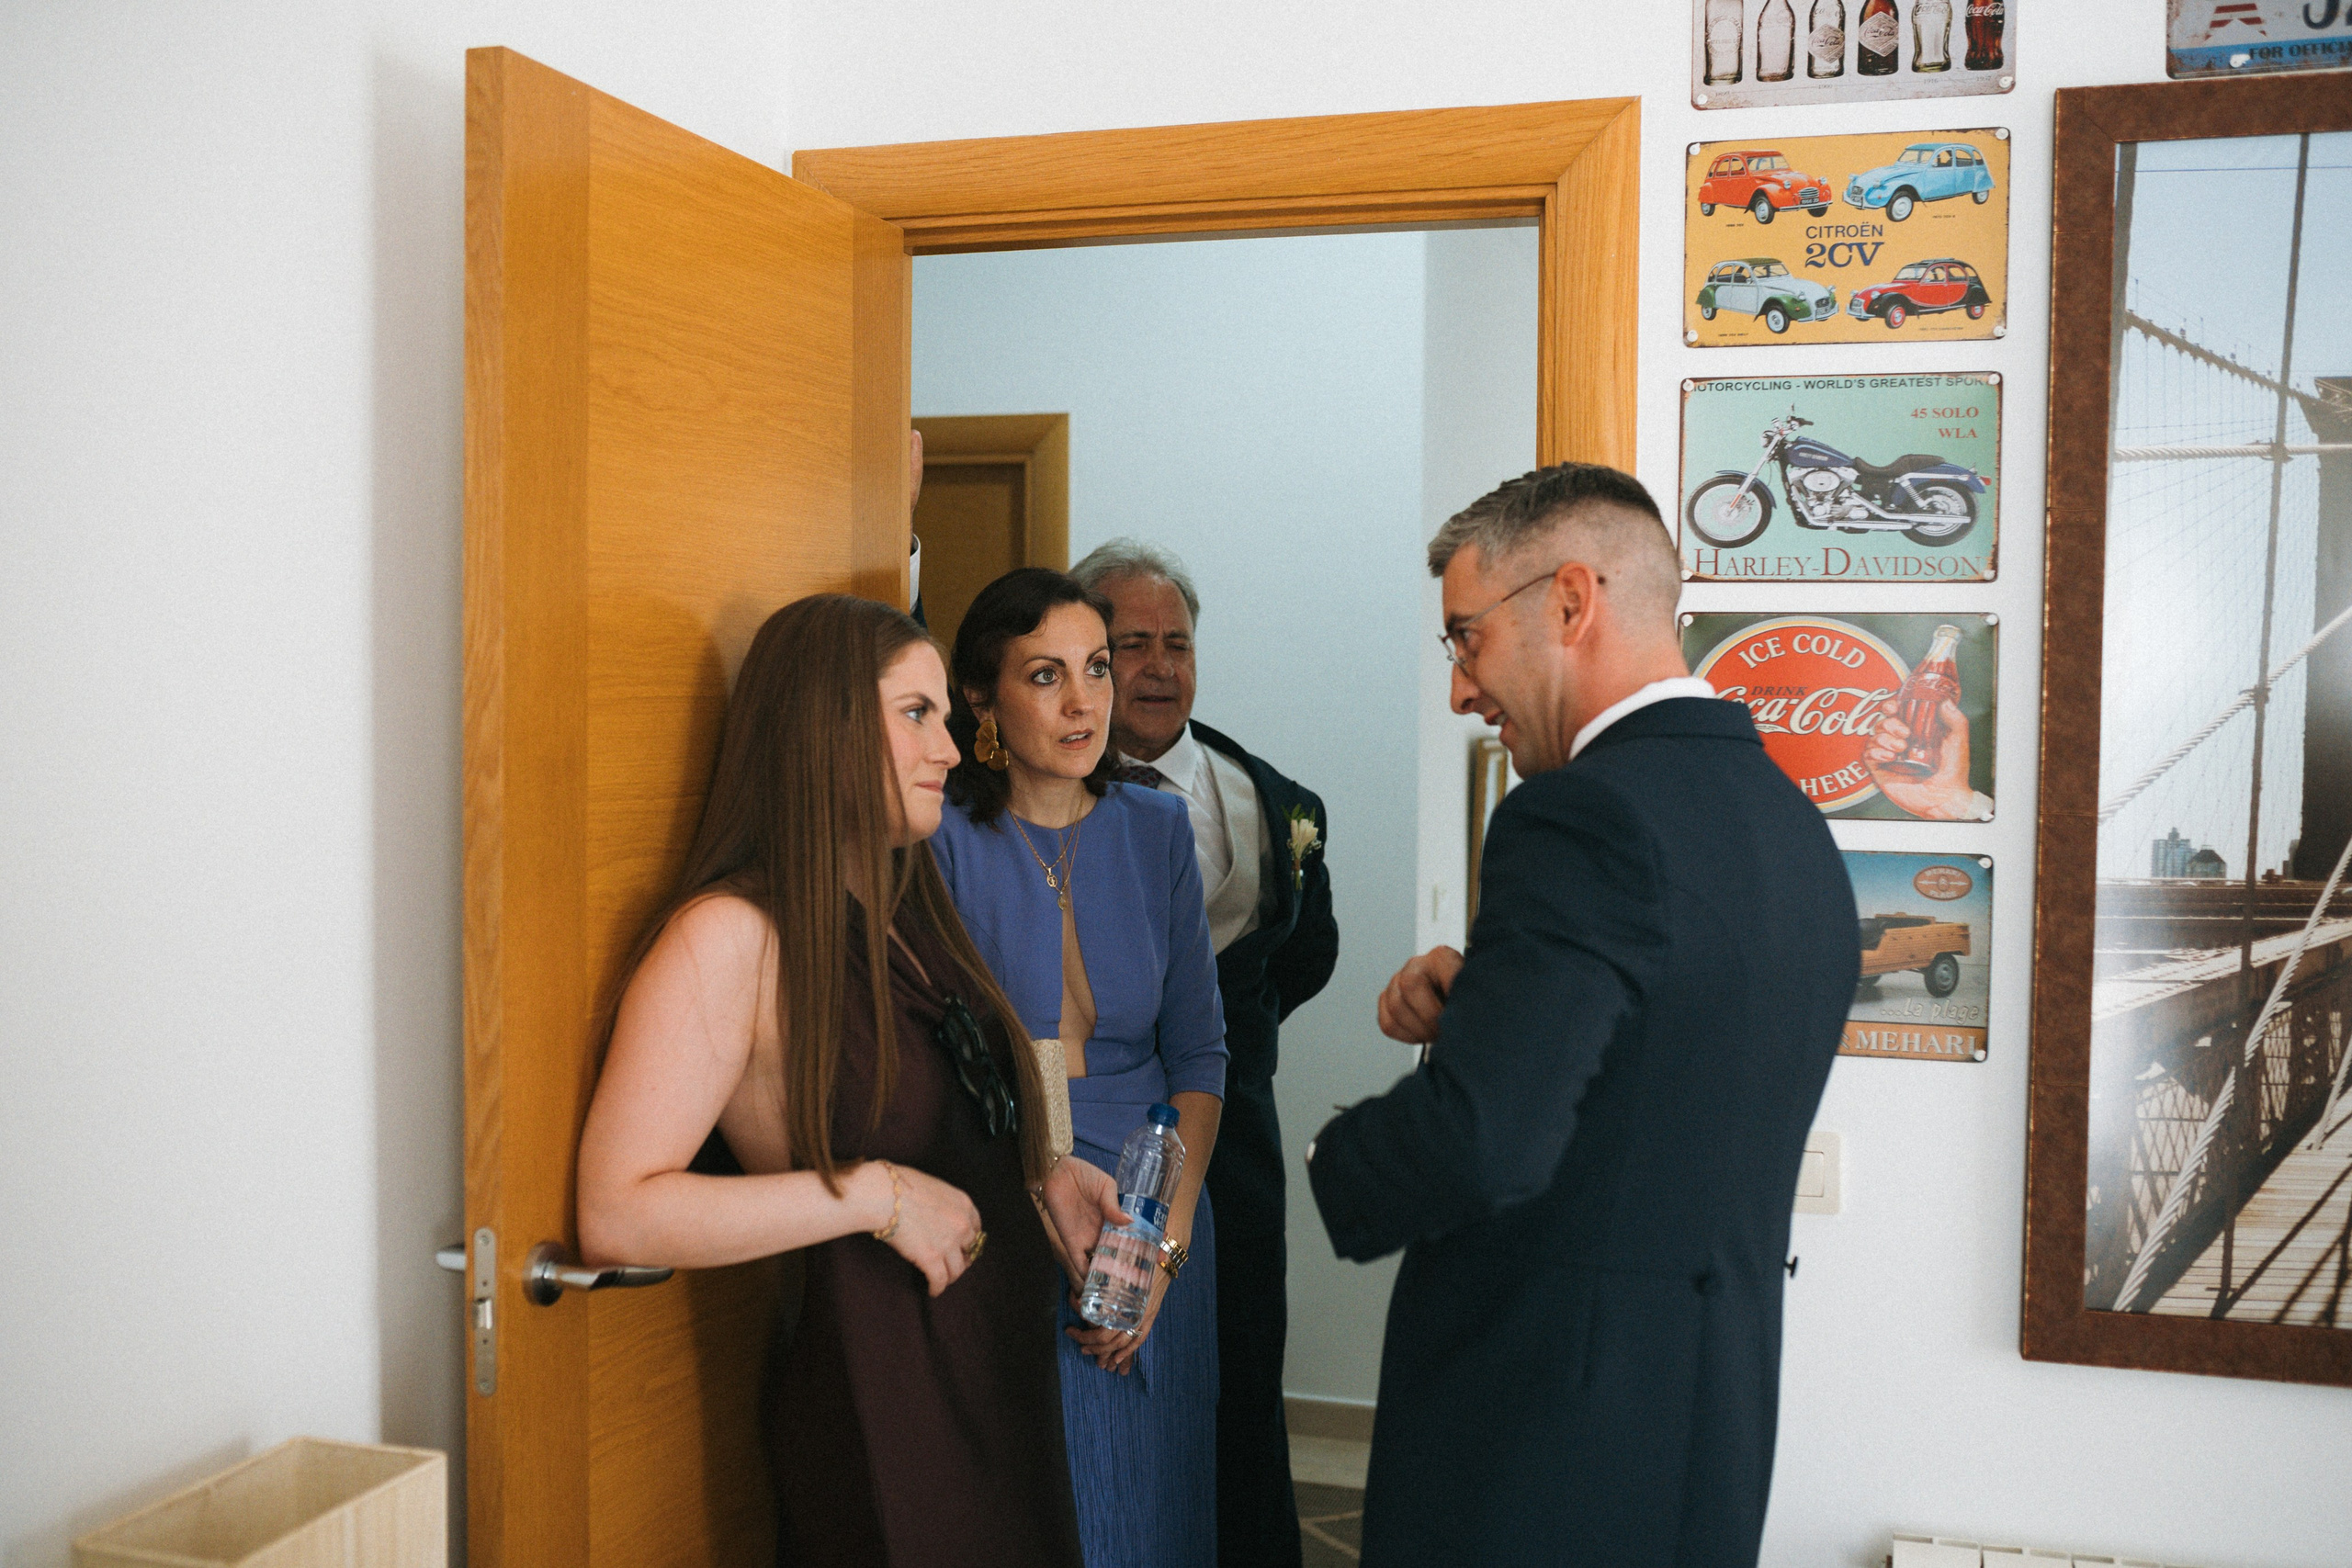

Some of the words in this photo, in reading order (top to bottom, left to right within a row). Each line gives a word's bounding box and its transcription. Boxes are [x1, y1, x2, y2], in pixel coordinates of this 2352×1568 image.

[2249, 47, 2284, 60] FOR
[1805, 221, 1883, 239] CITROËN
[1804, 242, 1884, 268] 2CV
[1804, 378, 1866, 389] WORLD'S
[1870, 377, 1941, 389] GREATEST
[1946, 376, 1990, 387] SPOR
[1910, 408, 1928, 419] 45
[1932, 406, 1979, 419] SOLO
[1939, 428, 1978, 439] WLA
[1738, 637, 1786, 669] ICE
[1792, 633, 1866, 669] COLD
[1751, 686, 1808, 696] DRINK
[1799, 761, 1871, 796] HERE
[1930, 999, 1980, 1025] plage
[1855, 1030, 1977, 1055] MEHARI
